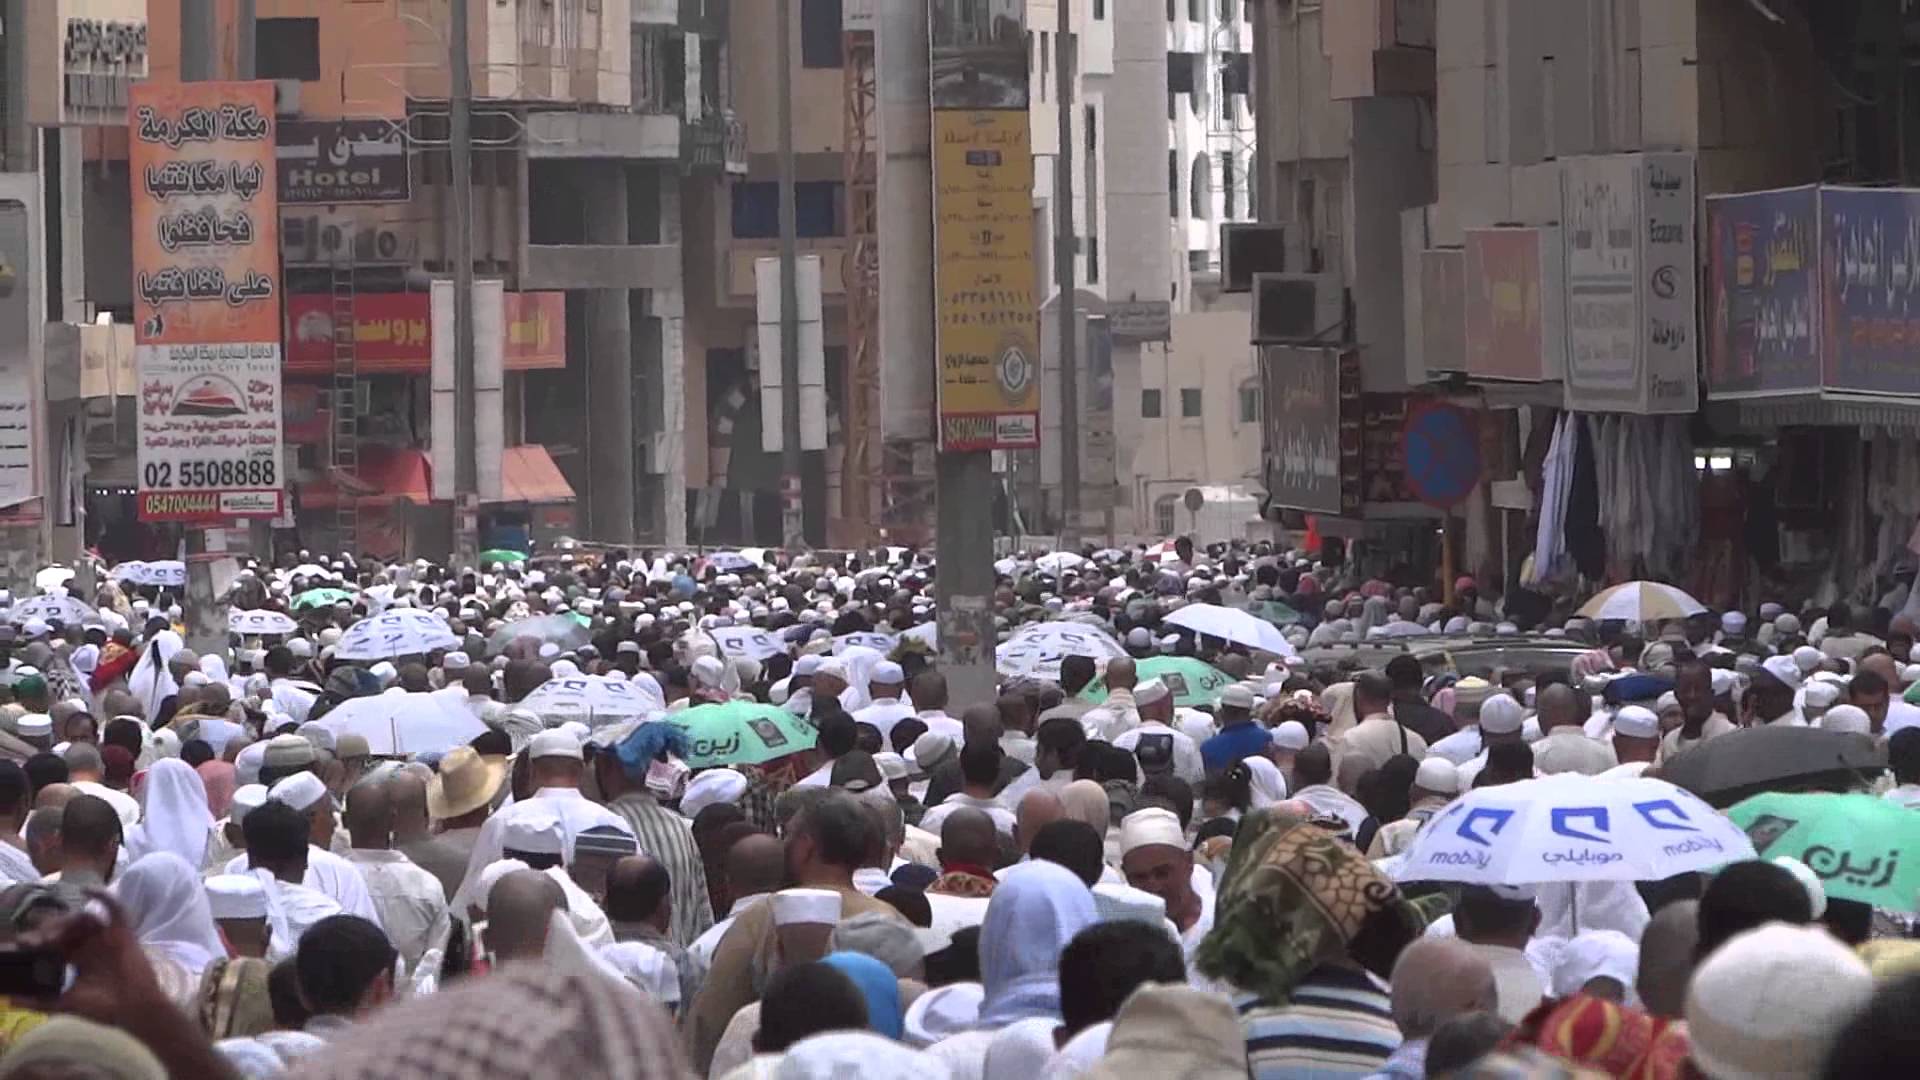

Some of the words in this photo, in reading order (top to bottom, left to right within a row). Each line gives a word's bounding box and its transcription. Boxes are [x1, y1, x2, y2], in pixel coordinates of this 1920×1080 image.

[138, 105, 218, 150] المكرمة
[221, 103, 269, 140] مكة
[145, 160, 227, 202] مكانتها
[230, 161, 263, 201] لها
[288, 168, 381, 187] Hotel
[159, 213, 254, 252] فحافظوا
[139, 264, 225, 308] نظافتها
[227, 270, 273, 307] على
[145, 461, 172, 488] 02
[179, 459, 275, 487] 5508888
[146, 494, 218, 514] 0547004444
[693, 732, 740, 756] زين
[1542, 847, 1623, 866] موبايلي
[1802, 845, 1899, 888] زين
